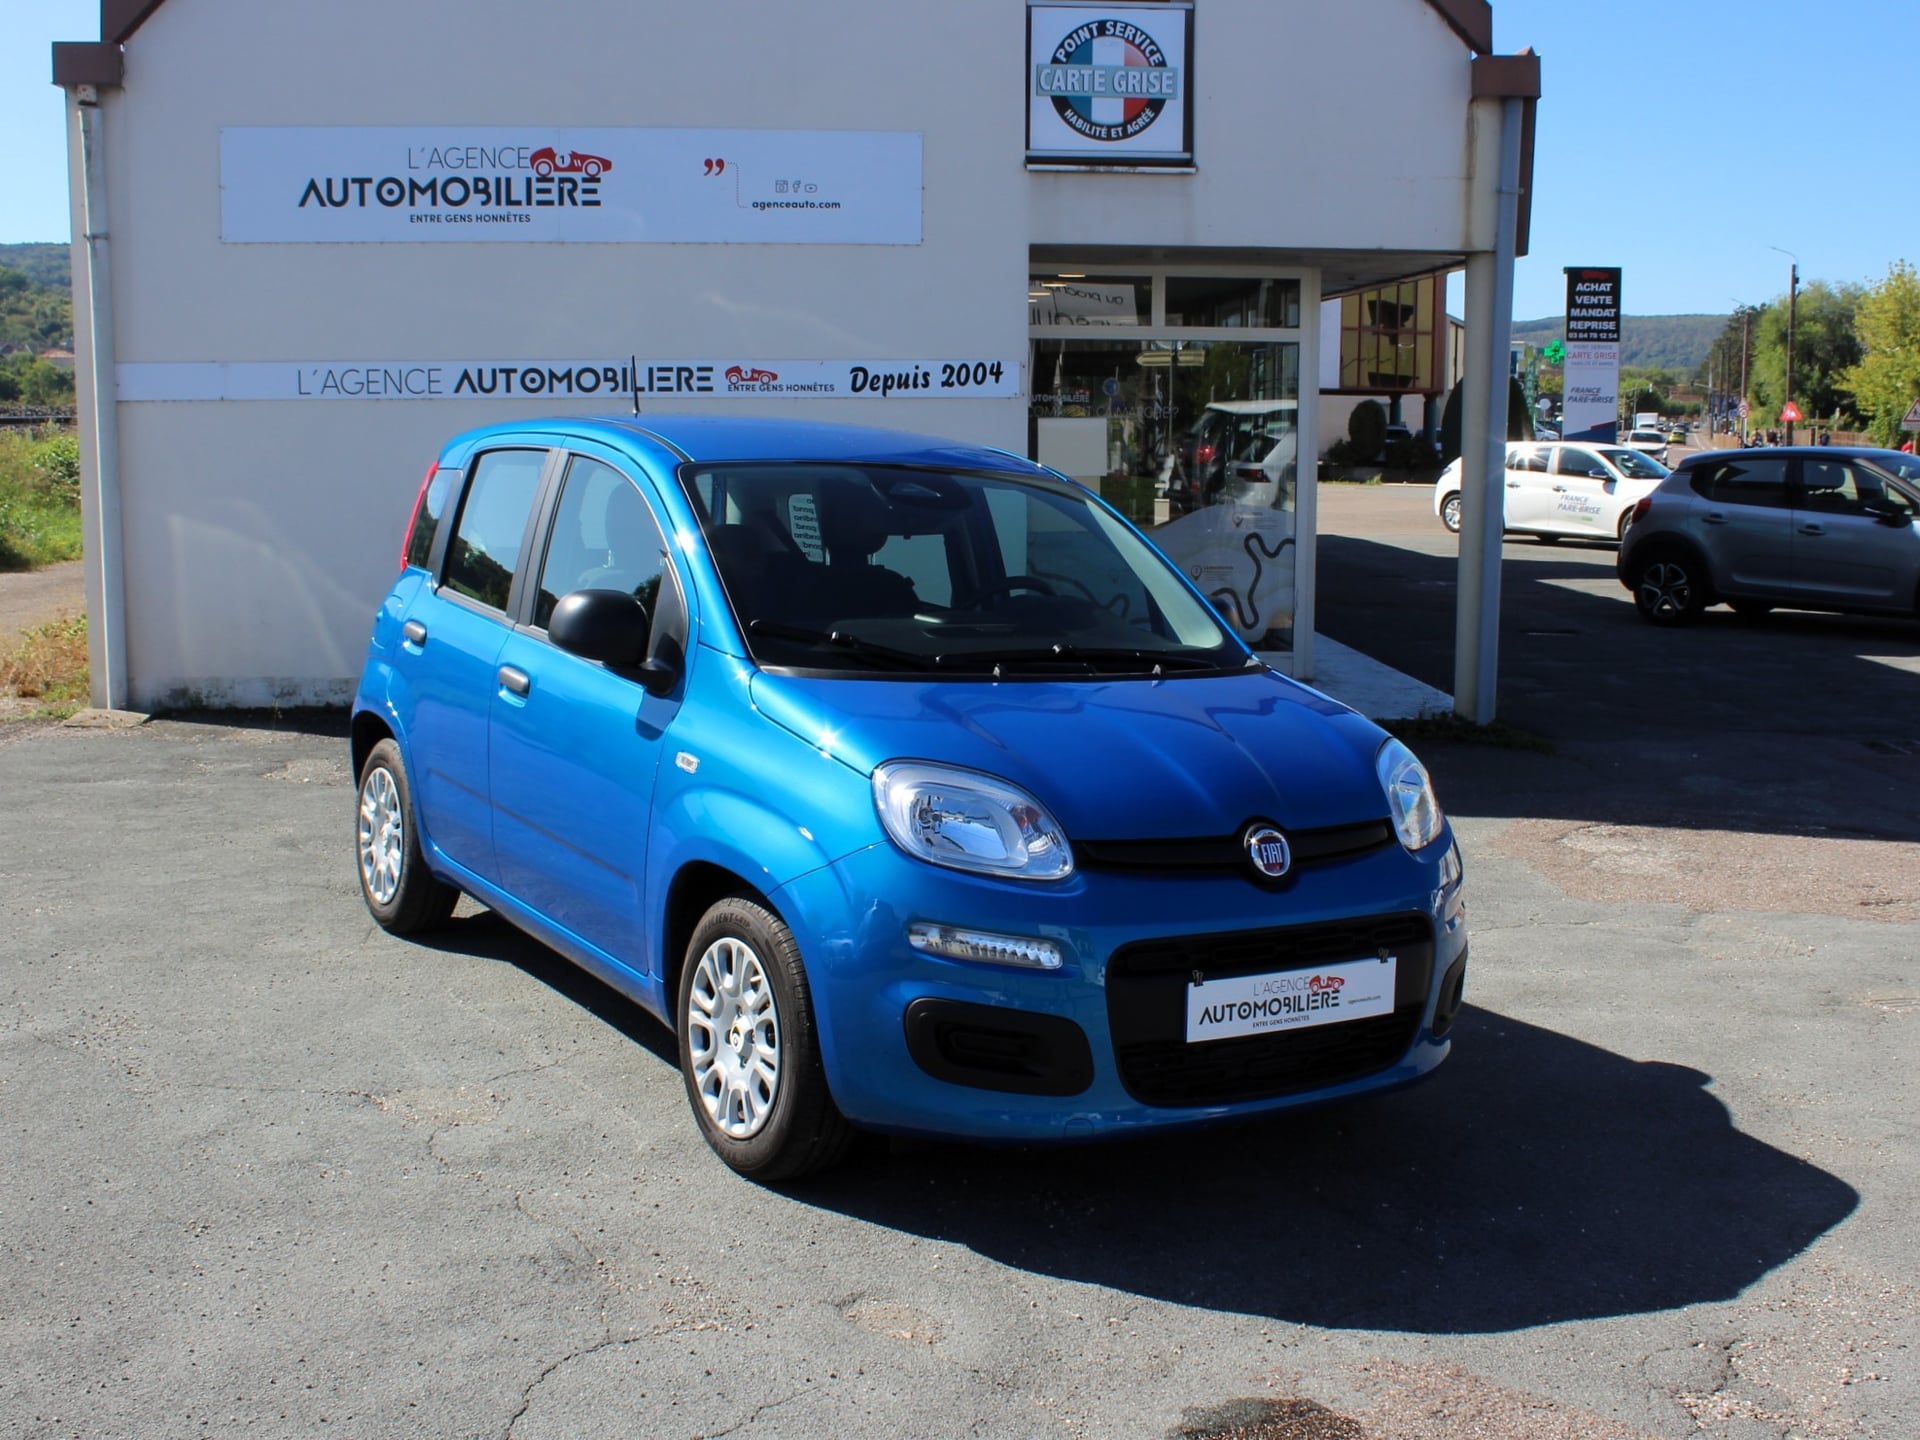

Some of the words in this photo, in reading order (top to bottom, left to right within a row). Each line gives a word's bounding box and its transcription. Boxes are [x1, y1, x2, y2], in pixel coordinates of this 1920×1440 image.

[1055, 22, 1098, 63] POINT
[1105, 21, 1162, 66] SERVICE
[1039, 69, 1105, 92] CARTE
[1113, 71, 1173, 94] GRISE
[1111, 127, 1123, 137] ET
[408, 147, 530, 169] L'AGENCE
[752, 201, 841, 211] agenceauto.com
[410, 214, 442, 223] ENTRE
[445, 214, 473, 223] GENS
[475, 211, 531, 223] HONNÊTES
[1576, 283, 1613, 292] ACHAT
[1575, 296, 1613, 304] VENTE
[1570, 308, 1617, 317] MANDAT
[1569, 321, 1616, 330] REPRISE
[298, 368, 442, 395] L'AGENCE
[850, 365, 930, 397] Depuis
[941, 360, 1004, 387] 2004
[728, 384, 757, 392] ENTRE
[759, 384, 784, 392] GENS
[786, 381, 835, 392] HONNÊTES
[1261, 843, 1283, 864] FIAT
[1253, 976, 1310, 996] L'AGENCE
